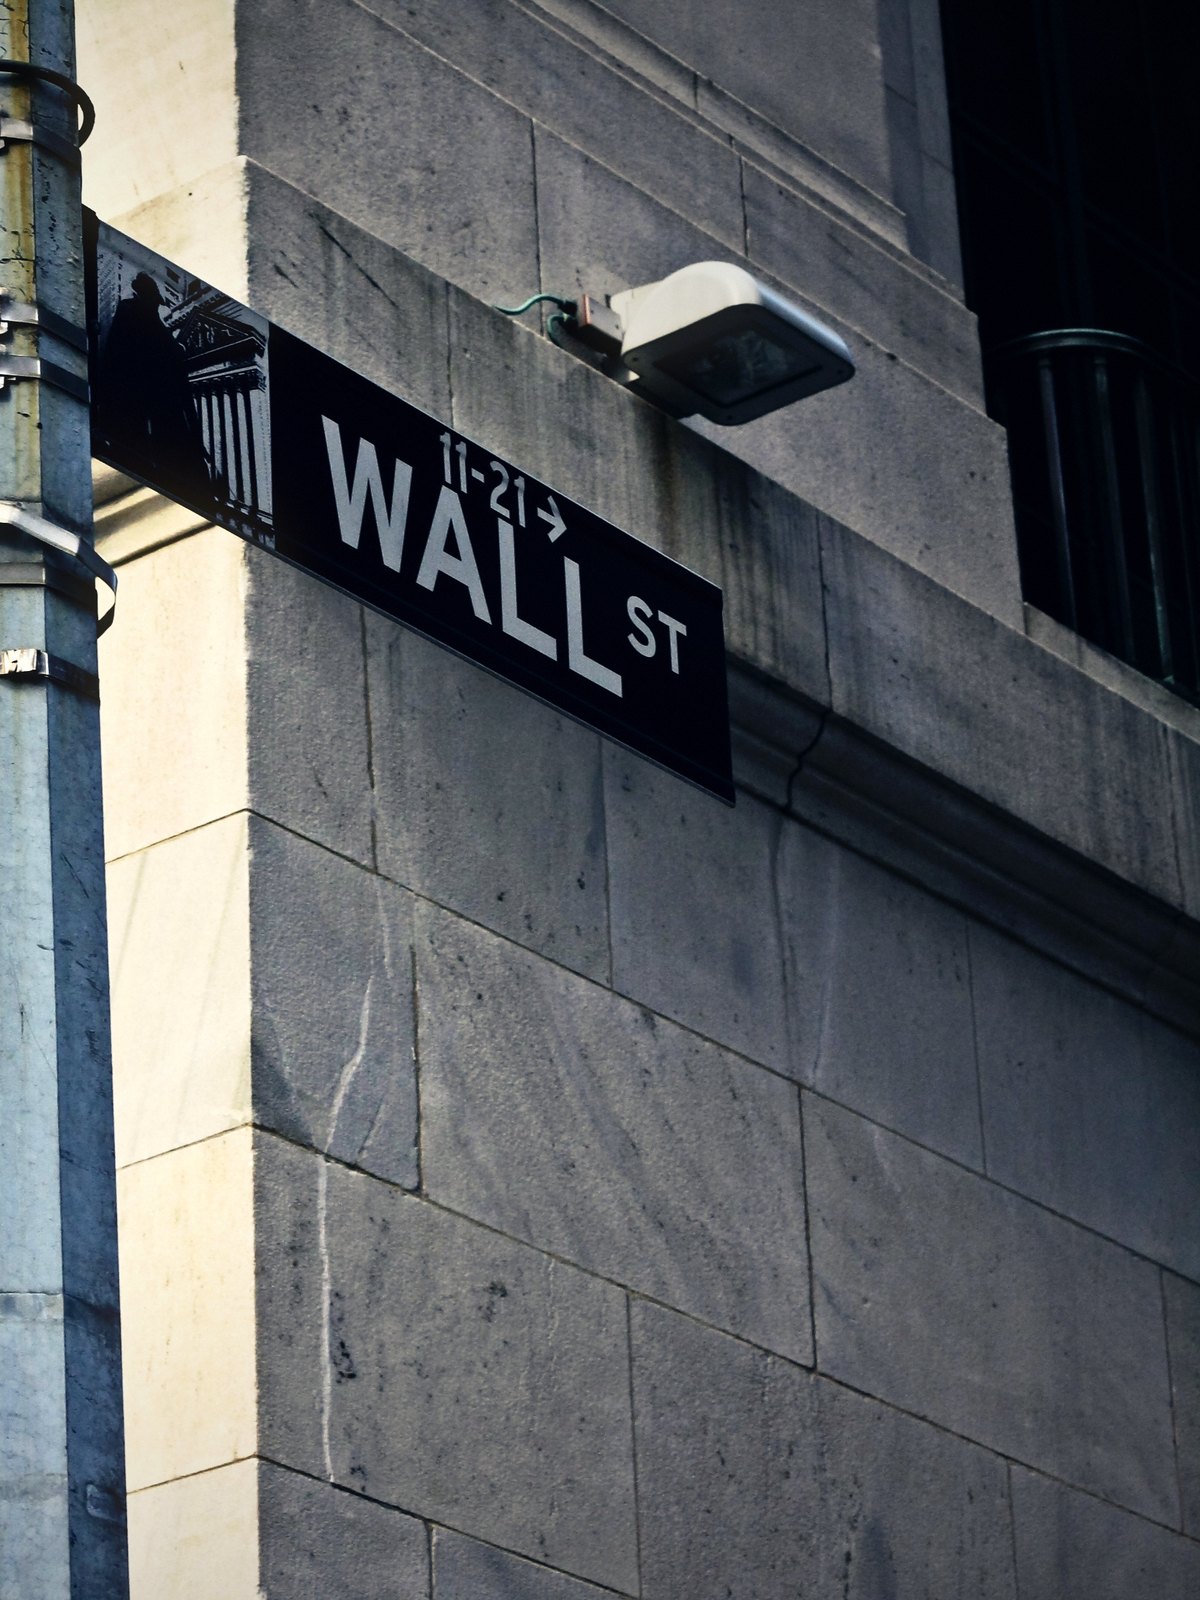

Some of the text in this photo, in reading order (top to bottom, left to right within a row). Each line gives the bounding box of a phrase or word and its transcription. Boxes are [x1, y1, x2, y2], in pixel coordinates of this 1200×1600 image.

[320, 414, 688, 699] WALL ST
[439, 431, 527, 529] 11-21
